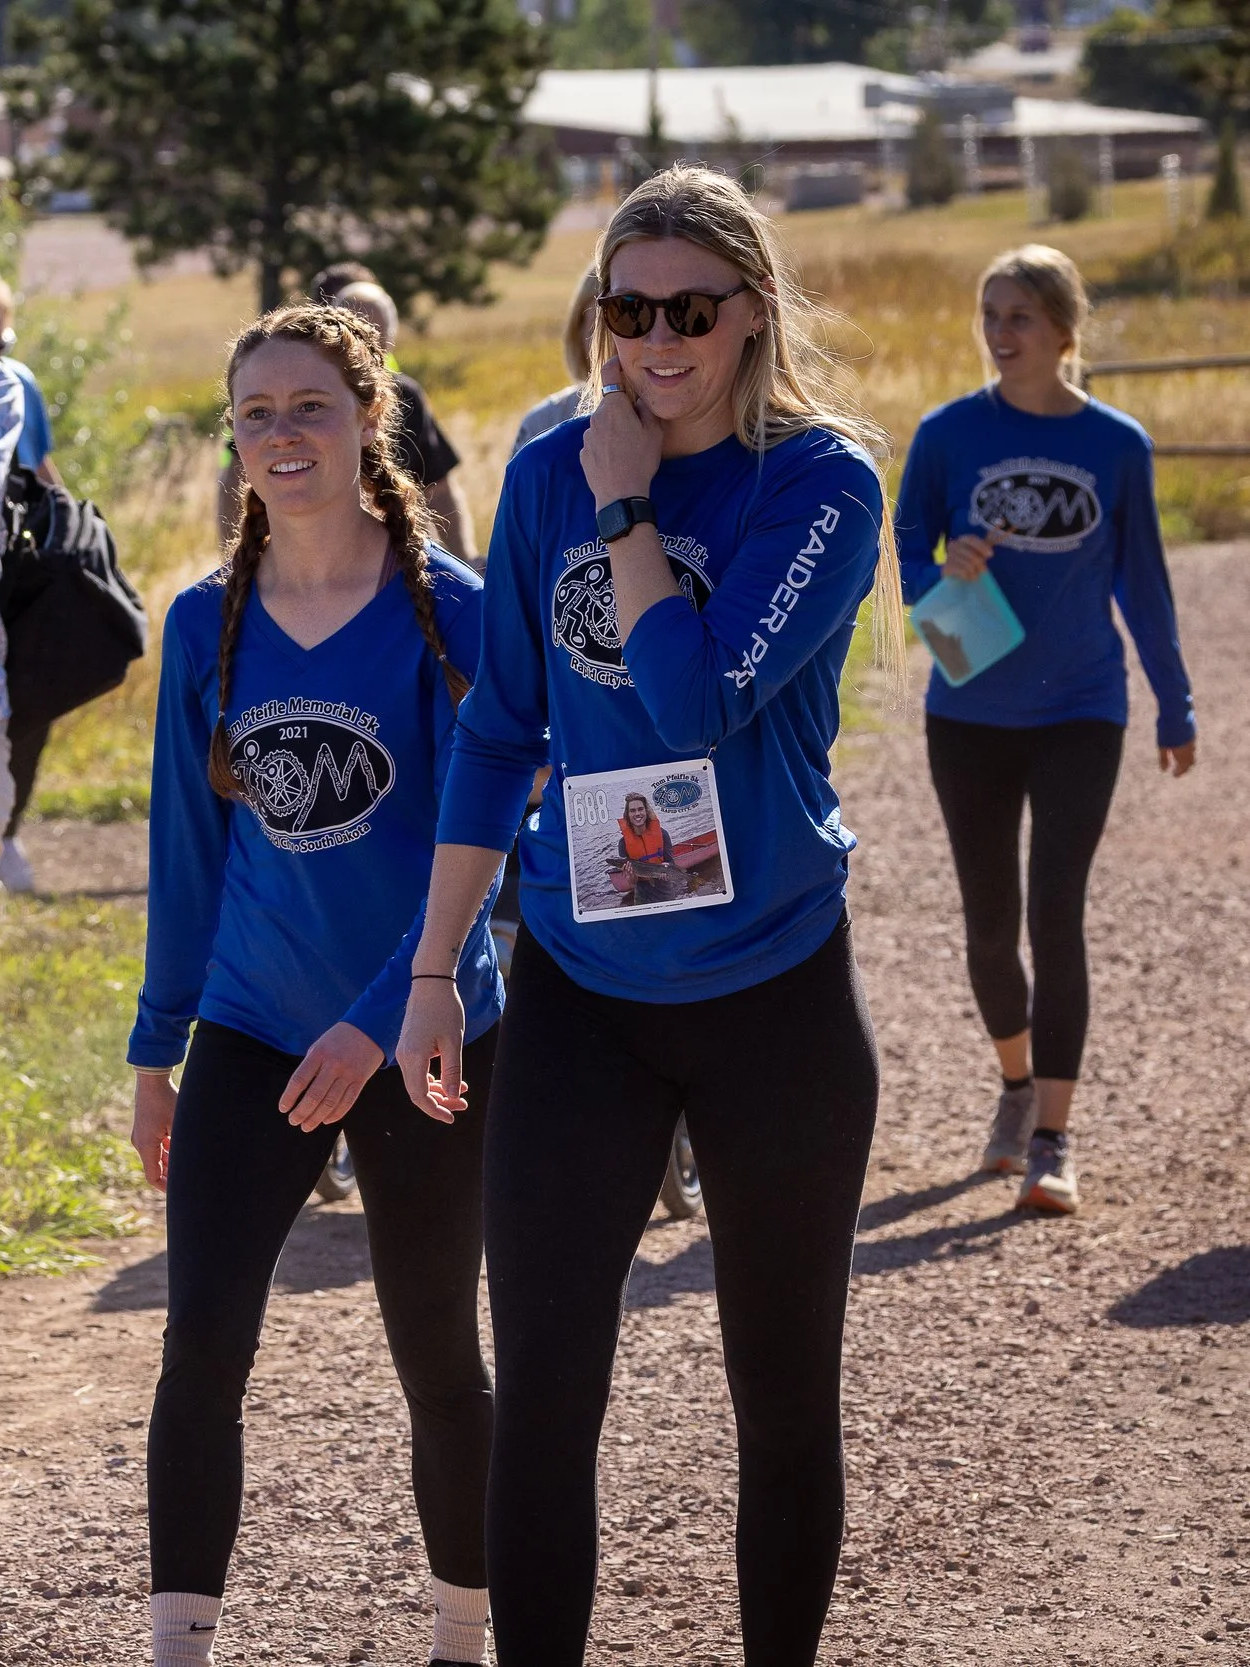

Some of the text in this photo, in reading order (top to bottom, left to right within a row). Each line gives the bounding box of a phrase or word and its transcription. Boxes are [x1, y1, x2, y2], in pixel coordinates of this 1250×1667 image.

[564, 542, 594, 564] Tom
[692, 544, 709, 567] 5k
[724, 504, 841, 695] RAIDER PAR
[570, 656, 596, 682] Rapid
[597, 671, 622, 689] City
[226, 696, 381, 741] om Pfeifle Memorial 5k
[278, 726, 308, 741] 2021
[651, 773, 700, 789] Tom Pfeifle 5k
[572, 789, 610, 827] 688
[300, 834, 337, 853] South
[335, 821, 372, 842] Dakota
